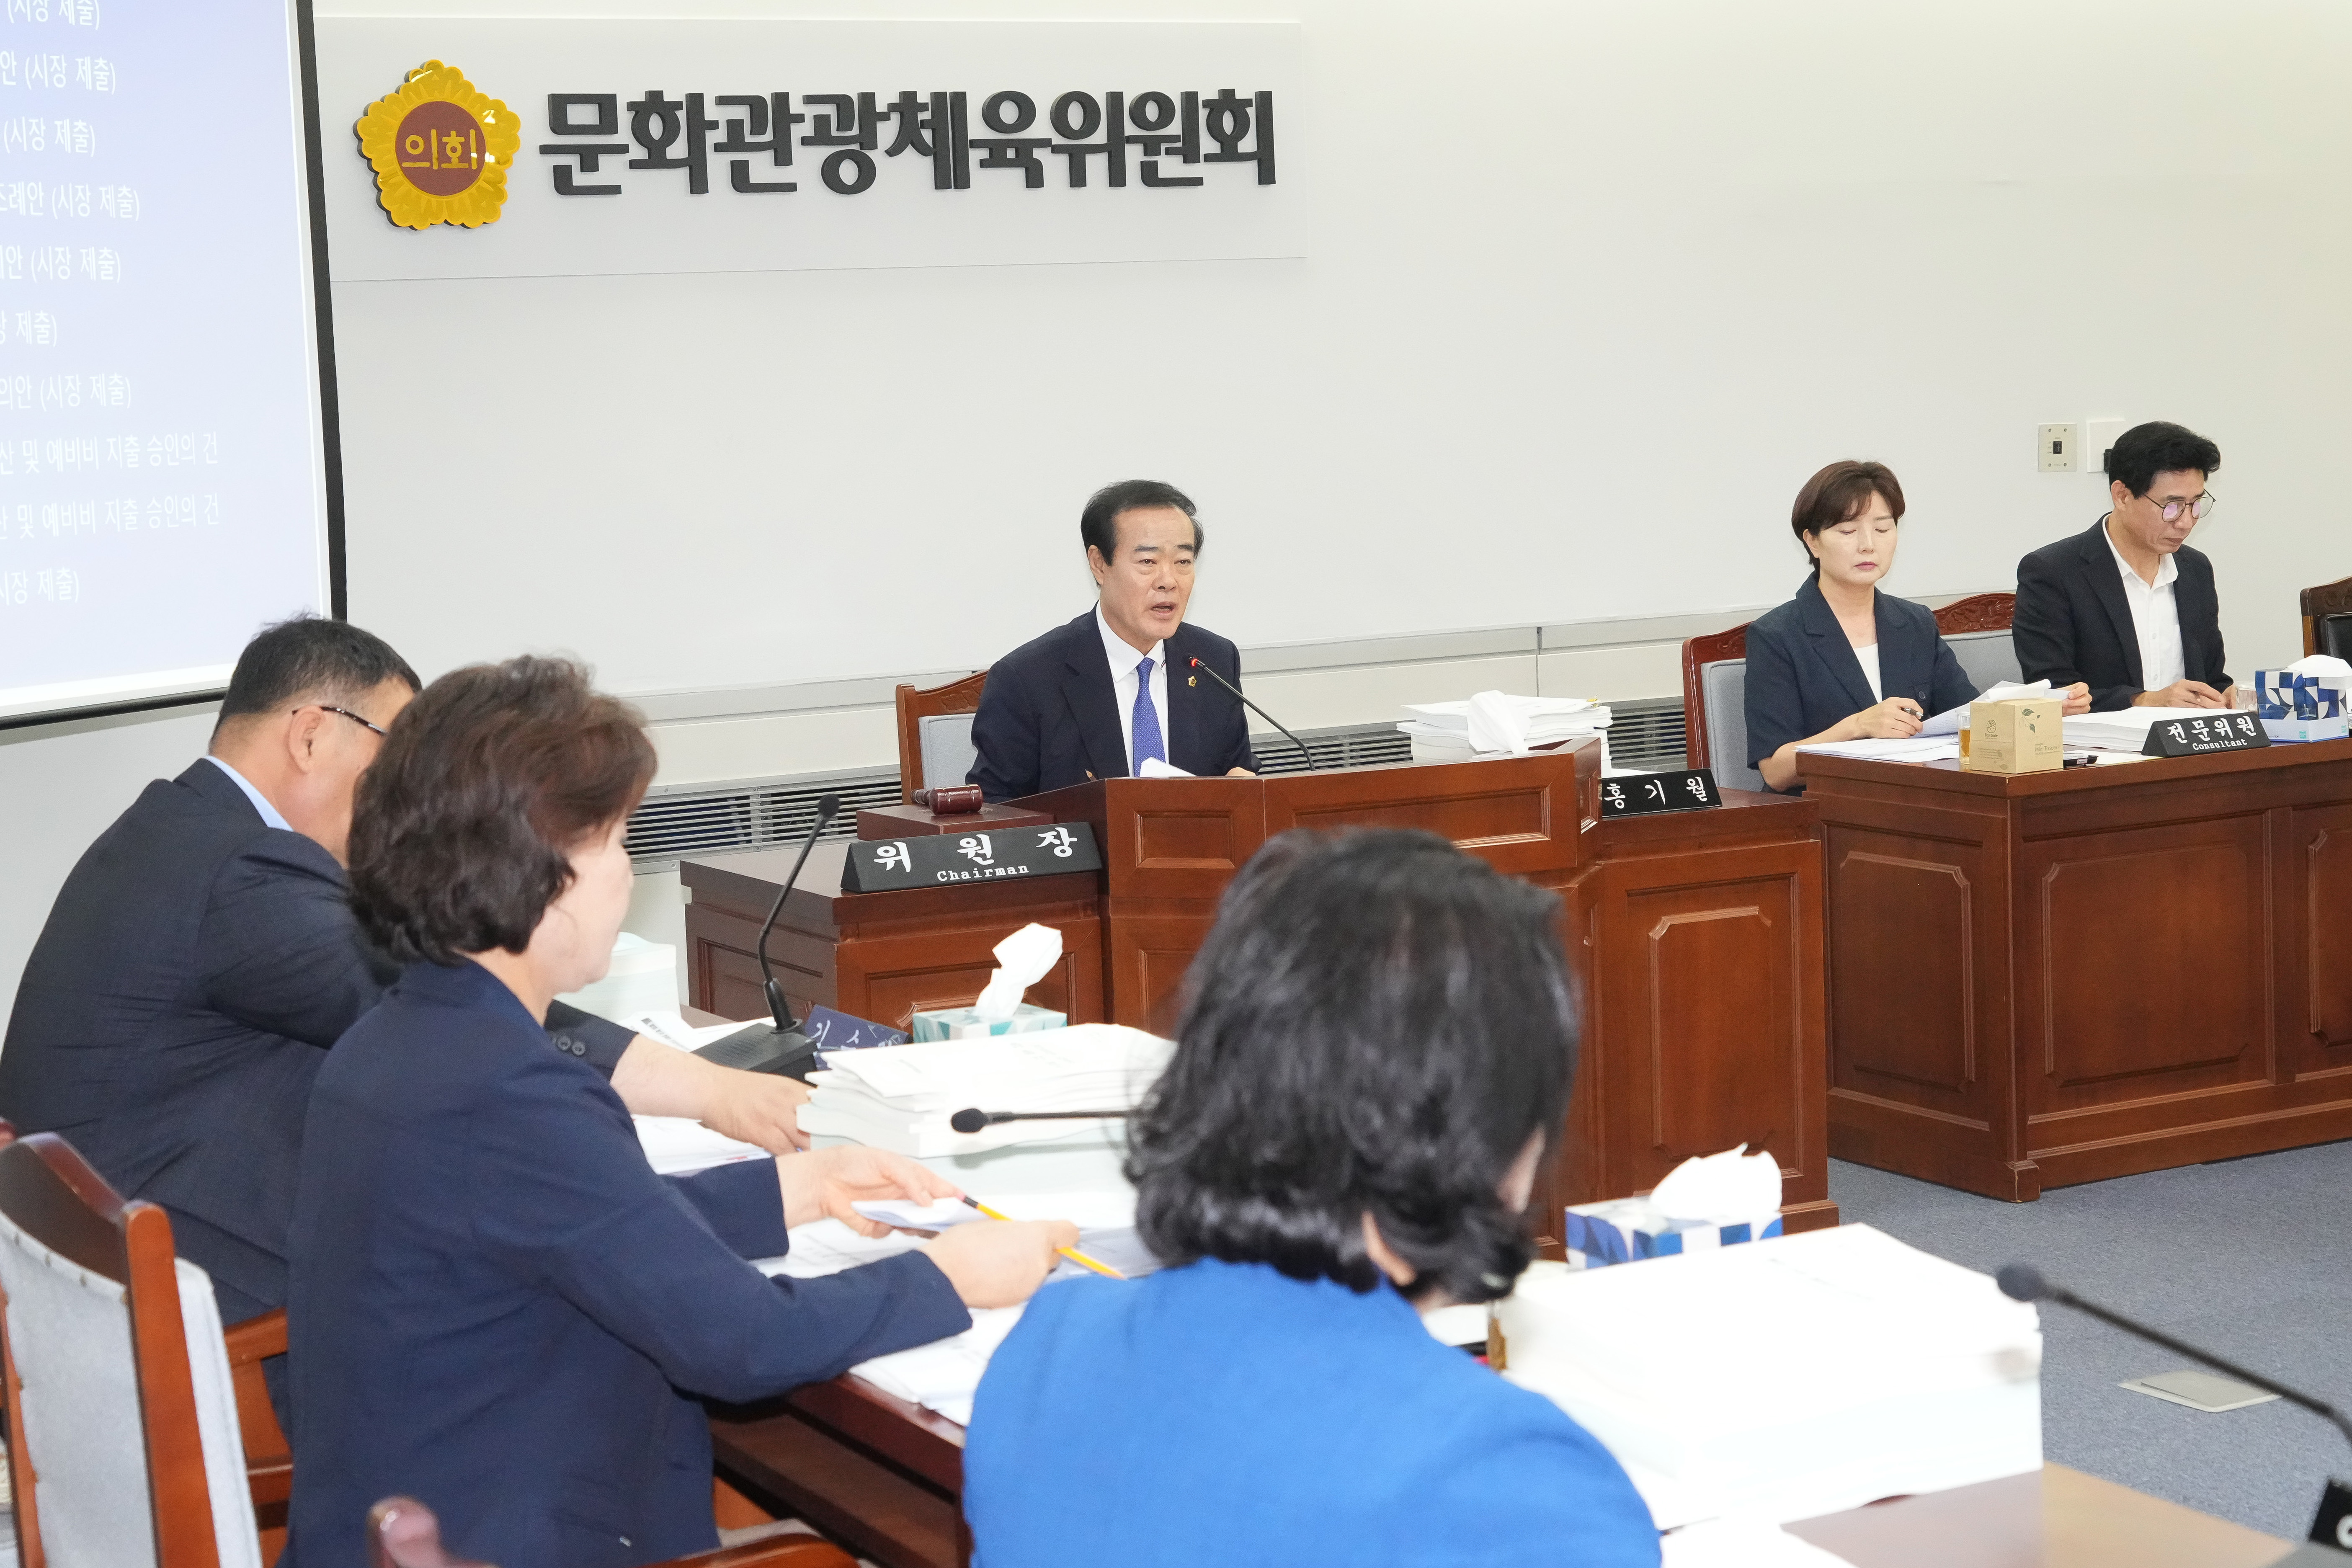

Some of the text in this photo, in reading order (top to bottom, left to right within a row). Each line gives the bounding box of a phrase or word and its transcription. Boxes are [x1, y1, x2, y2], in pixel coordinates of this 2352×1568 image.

[8, 0, 100, 30] (시장 제출)
[0, 51, 116, 95] 안 (시장 제출)
[4, 116, 95, 157] (시장 제출)
[402, 89, 1276, 195] 의회 문화관광체육위원회
[52, 183, 91, 219] (시장
[99, 185, 139, 221] 제출)
[0, 245, 121, 283] 안 (시장 제출)
[15, 310, 57, 347] 제출)
[0, 373, 131, 411] 의안 (시장 제출)
[23, 439, 39, 474] 및
[46, 437, 99, 472] 예비비
[106, 435, 140, 468] 지출
[147, 433, 196, 466] 승인의
[204, 431, 218, 464] 건
[17, 504, 34, 539] 및
[42, 500, 95, 536] 예비비
[105, 498, 138, 532] 지출
[147, 495, 196, 529] 승인의
[204, 493, 219, 525] 건
[37, 567, 79, 602] 제출)
[2167, 715, 2257, 744] 전문위원
[2192, 738, 2247, 750] Consultant
[1604, 776, 1707, 809] 홍기월
[874, 827, 1078, 873] 위원장
[937, 865, 1029, 881] Chairman
